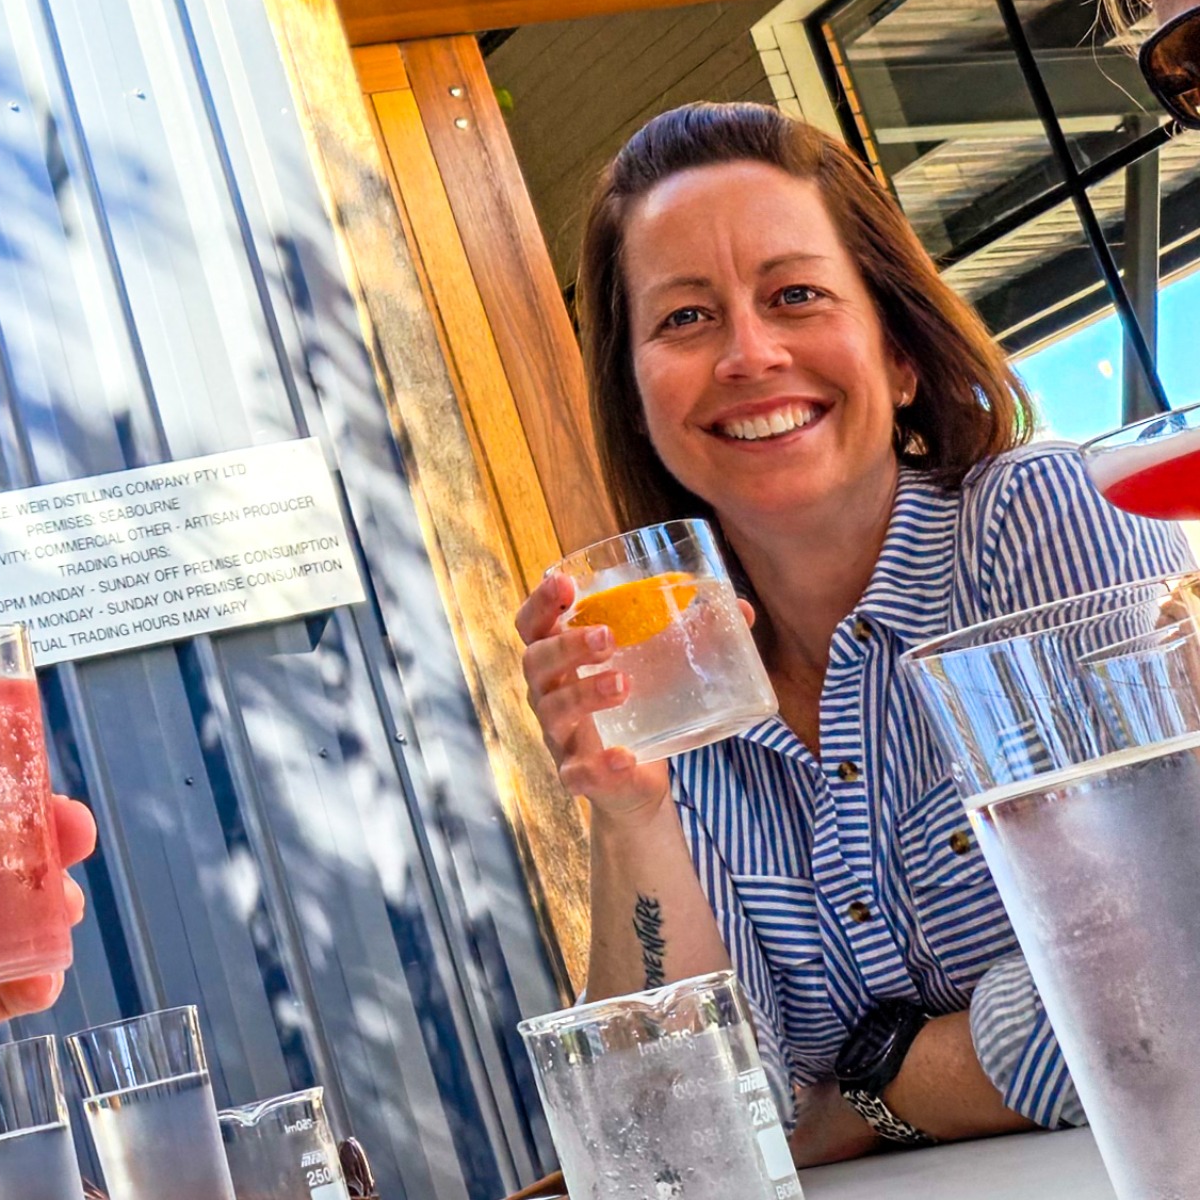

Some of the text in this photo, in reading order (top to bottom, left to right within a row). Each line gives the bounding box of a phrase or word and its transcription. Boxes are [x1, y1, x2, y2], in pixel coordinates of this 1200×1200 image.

[16, 499, 50, 516] WEIR
[54, 486, 123, 509] DISTILLING
[126, 473, 190, 496] COMPANY
[194, 468, 219, 484] PTY
[223, 463, 247, 478] LTD
[26, 497, 181, 537] PREMISES: SEABOURNE
[35, 531, 125, 560] COMMERCIAL
[128, 521, 173, 542] OTHER
[184, 510, 240, 531] ARTISAN
[243, 495, 316, 518] PRODUCER
[29, 584, 86, 608] MONDAY
[98, 573, 151, 595] SUNDAY
[154, 566, 180, 583] OFF
[183, 554, 241, 578] PREMISE
[243, 535, 340, 566] CONSUMPTION
[58, 545, 171, 578] TRADING HOURS:
[37, 606, 95, 630] MONDAY
[107, 594, 159, 616] SUNDAY
[163, 589, 185, 605] ON
[186, 576, 246, 600] PREMISE
[247, 558, 343, 588] CONSUMPTION
[31, 599, 249, 654] TUAL TRADING HOURS MAY VARY
[306, 1166, 331, 1187] 250
